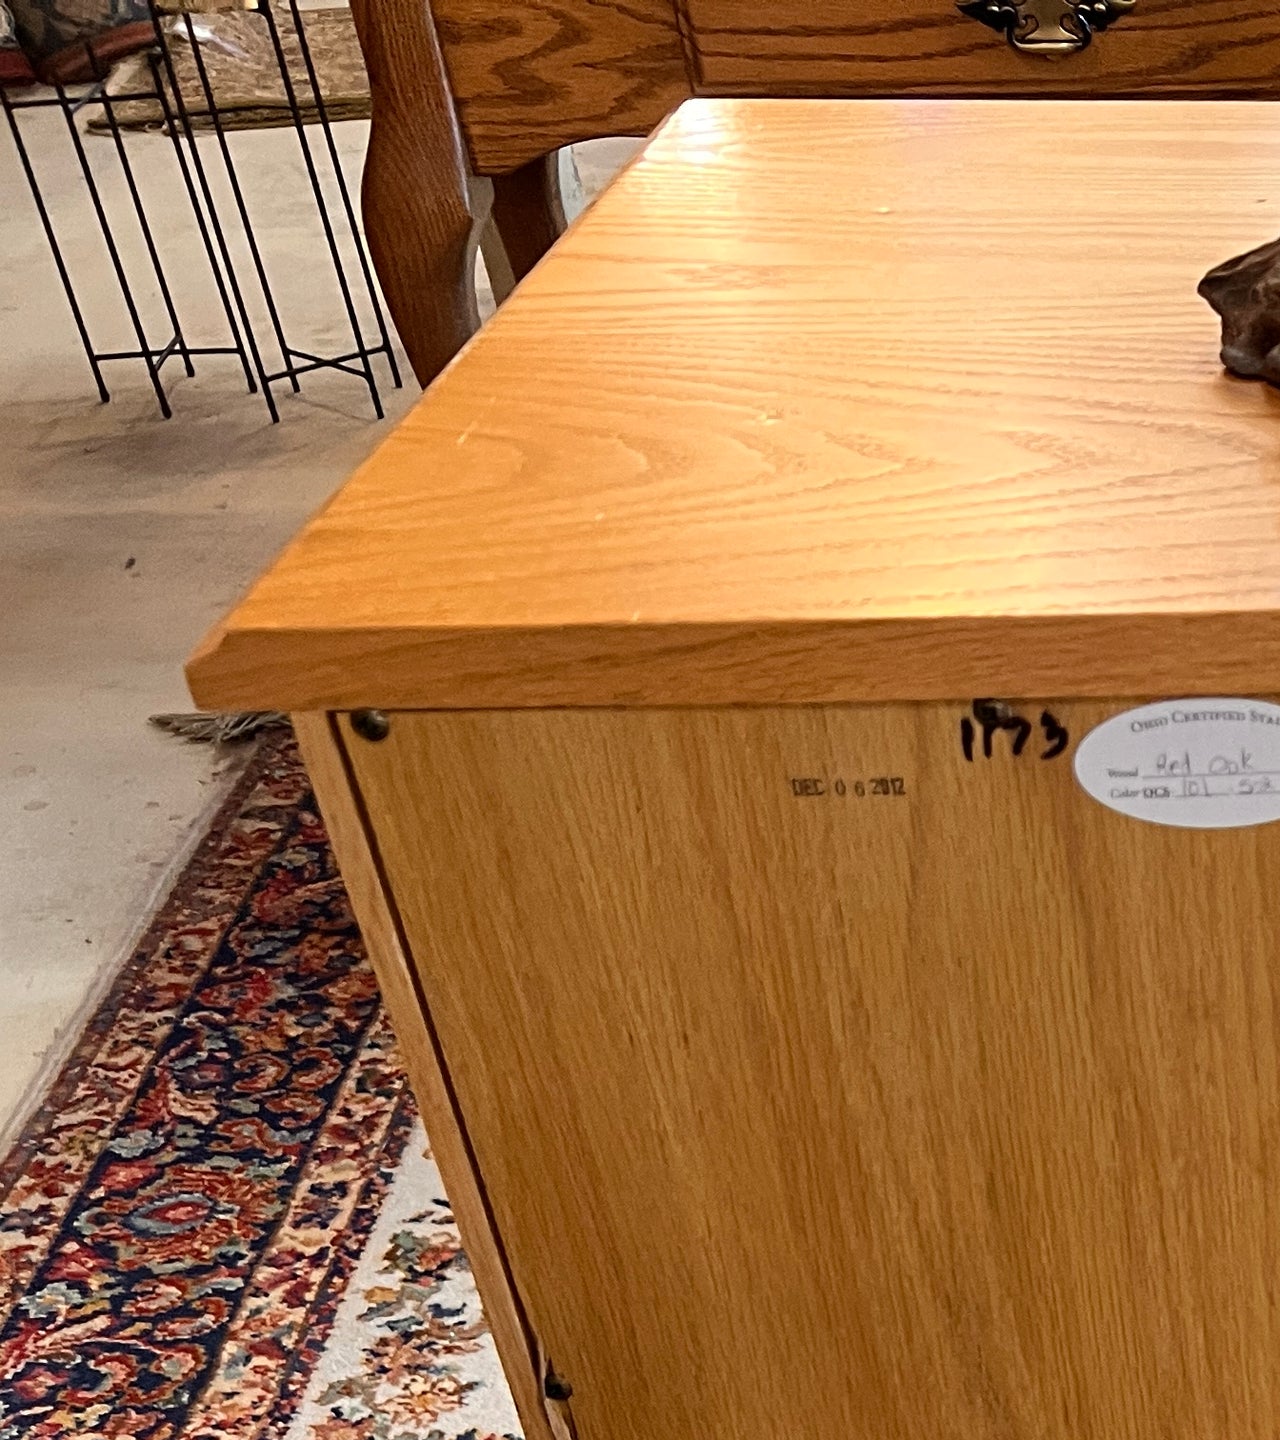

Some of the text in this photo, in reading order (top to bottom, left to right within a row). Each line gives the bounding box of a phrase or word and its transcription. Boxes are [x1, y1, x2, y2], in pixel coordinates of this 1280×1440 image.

[1156, 751, 1192, 776] Red
[1208, 748, 1254, 775] Oak
[791, 778, 825, 796] DEC
